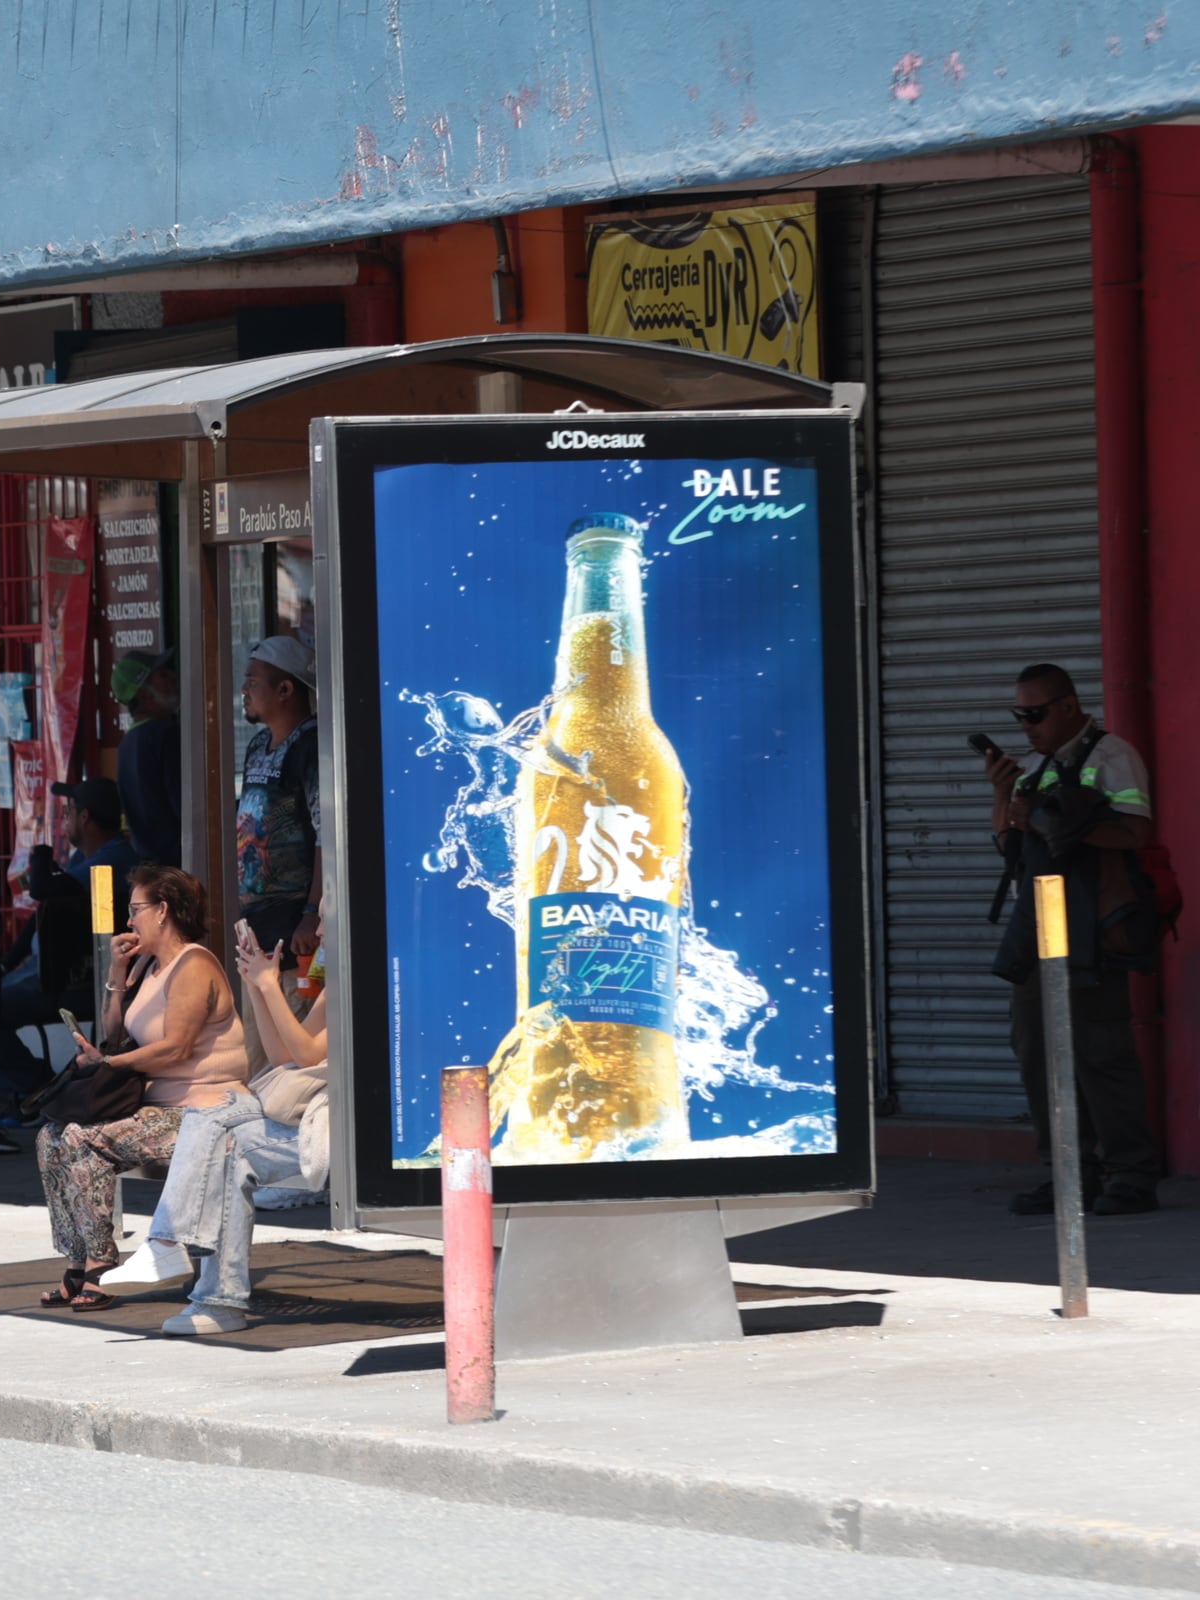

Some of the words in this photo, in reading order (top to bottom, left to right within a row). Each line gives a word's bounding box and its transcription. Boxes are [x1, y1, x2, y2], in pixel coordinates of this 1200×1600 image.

[622, 255, 699, 296] Cerrajería
[546, 430, 646, 449] JCDecaux
[693, 467, 781, 497] DALE
[202, 489, 211, 530] 11737
[240, 503, 276, 533] Parabús
[279, 503, 301, 529] Paso
[103, 513, 158, 538] SALCHICHÓN
[105, 545, 159, 566] MORTADELA
[117, 570, 148, 592] JAMÓN
[107, 601, 160, 621] SALCHICHAS
[115, 630, 153, 648] CHORIZO
[541, 904, 673, 936] BAVARIA
